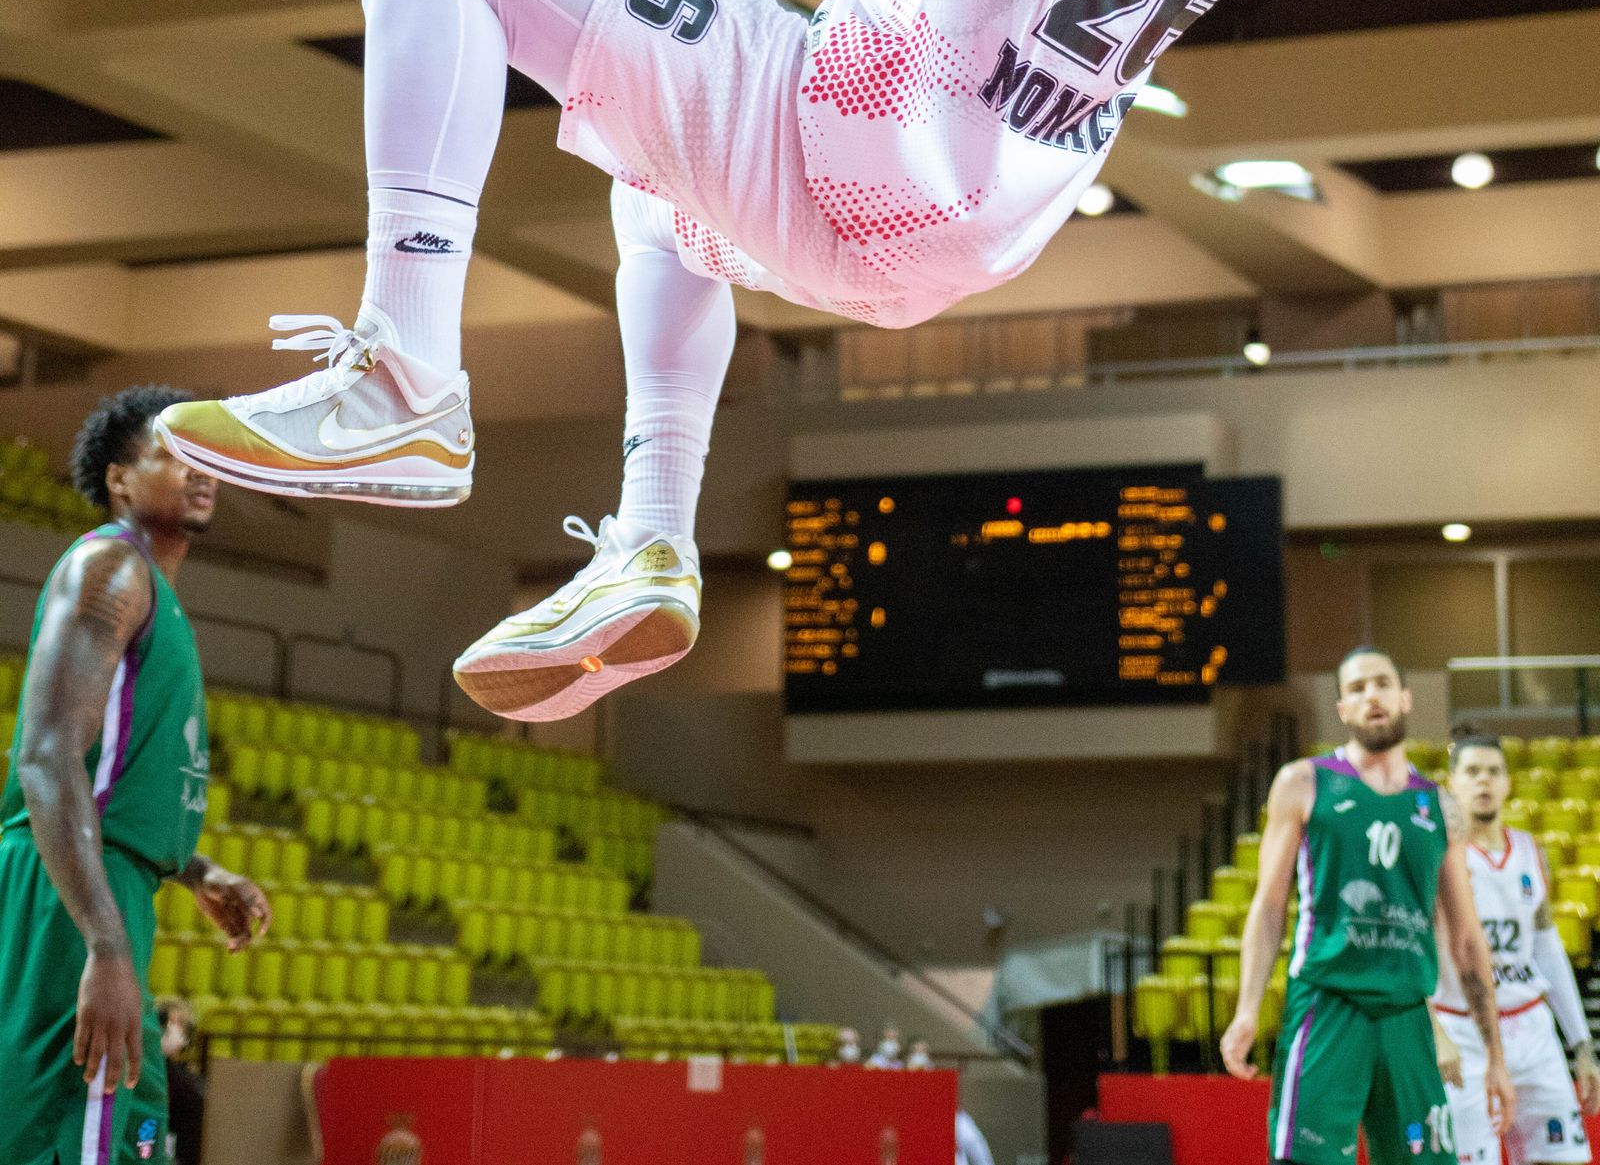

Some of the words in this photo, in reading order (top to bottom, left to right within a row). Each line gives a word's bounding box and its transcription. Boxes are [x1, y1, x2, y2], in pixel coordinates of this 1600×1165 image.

[409, 231, 454, 249] NIKE
[1365, 820, 1402, 871] 10
[1481, 919, 1520, 951] 32
